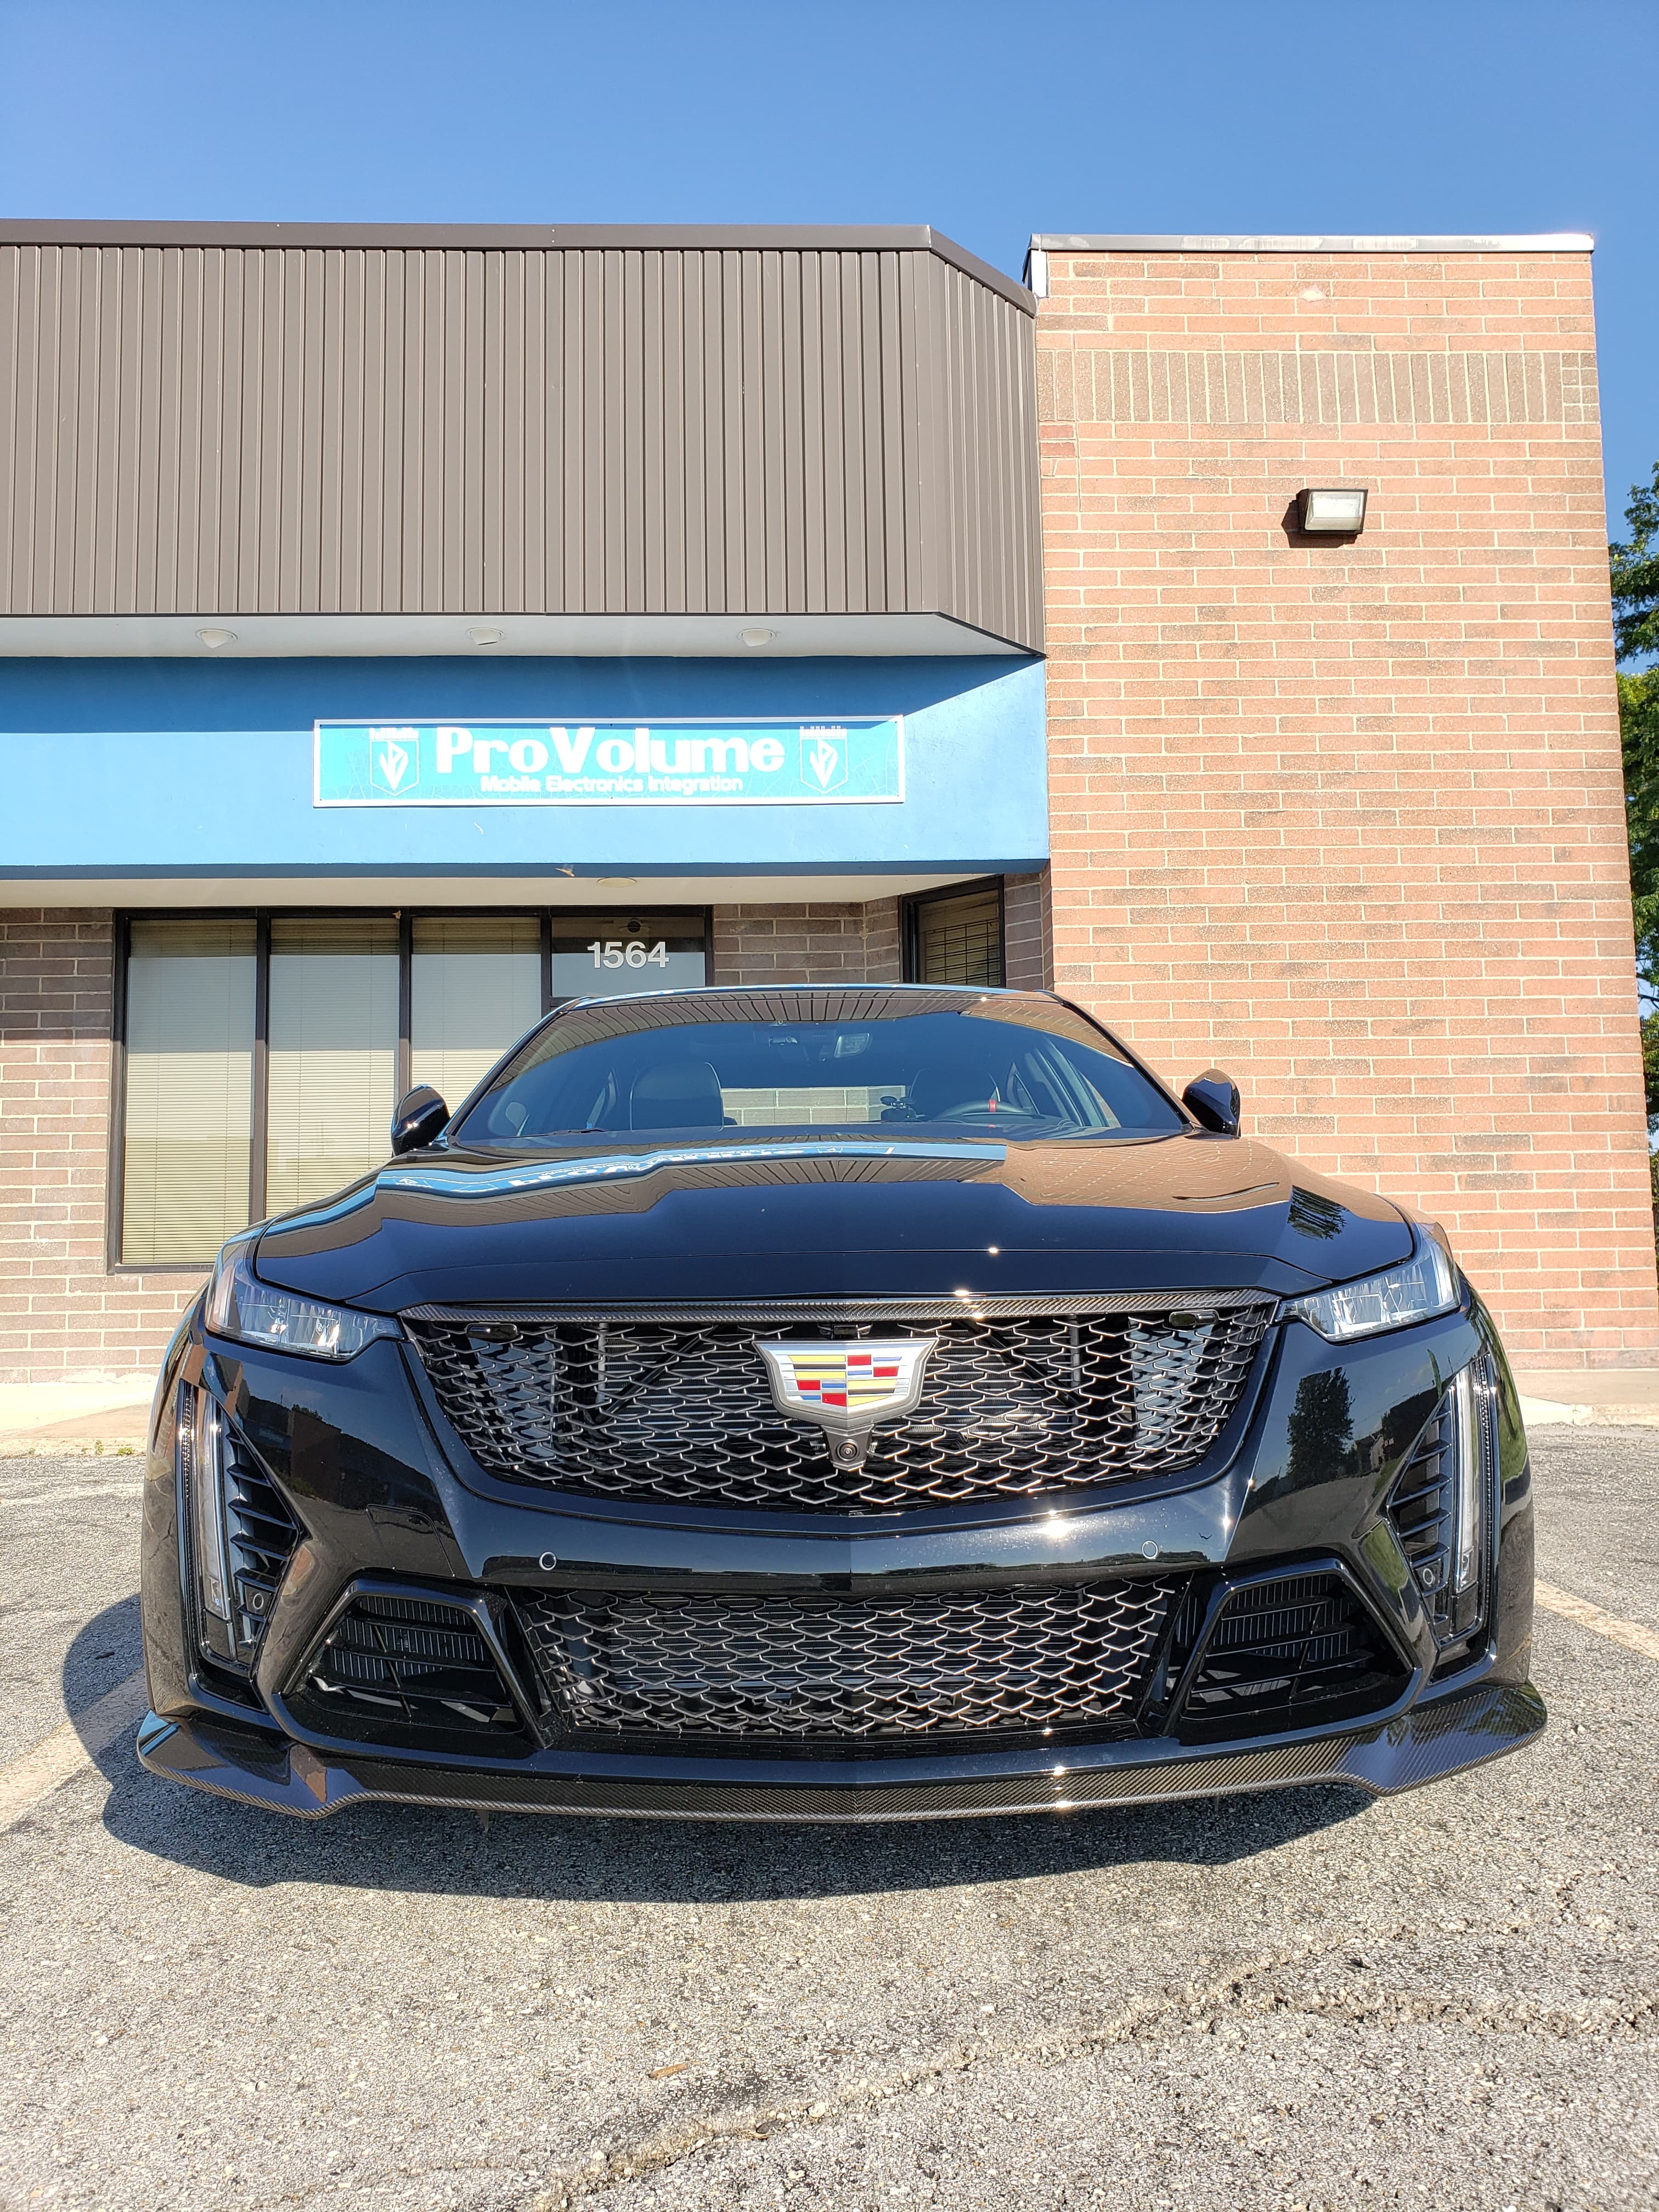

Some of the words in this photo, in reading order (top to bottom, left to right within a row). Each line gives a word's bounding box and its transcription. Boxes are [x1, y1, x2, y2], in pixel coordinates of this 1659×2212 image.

[436, 727, 785, 774] ProVolume
[480, 775, 541, 792] Mobile
[545, 775, 644, 792] Electronics
[648, 774, 743, 795] Integration
[587, 941, 670, 968] 1564
